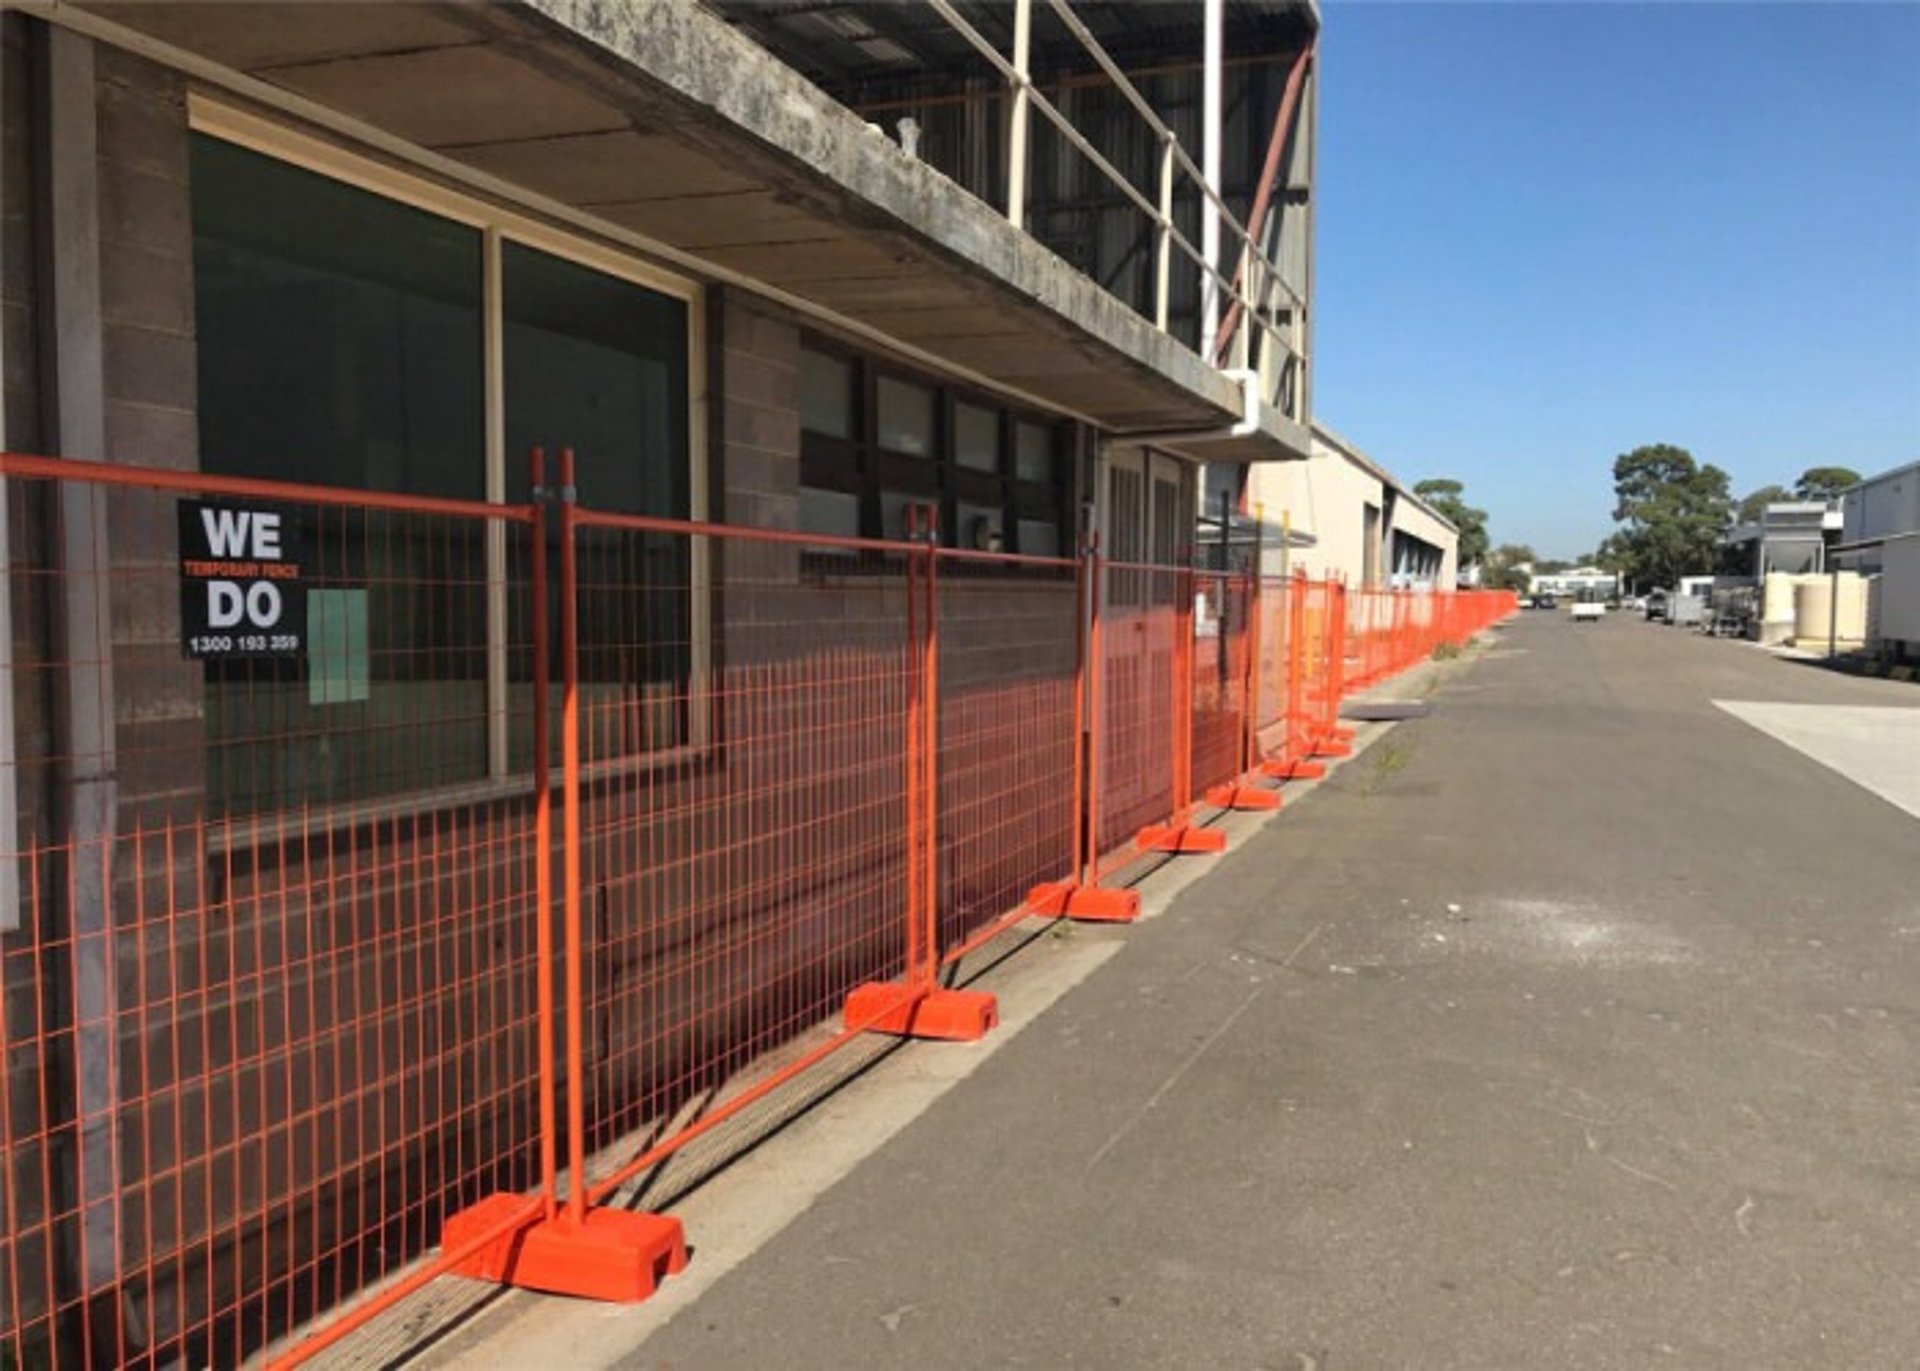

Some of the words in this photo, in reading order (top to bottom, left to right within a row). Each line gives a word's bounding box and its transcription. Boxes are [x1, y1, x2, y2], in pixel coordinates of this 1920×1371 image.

[201, 508, 281, 558] WE
[184, 560, 258, 577] TEMPORARY
[263, 563, 298, 579] FENCE
[207, 580, 282, 629] DO
[190, 635, 232, 652] 1300
[237, 635, 267, 650] 193
